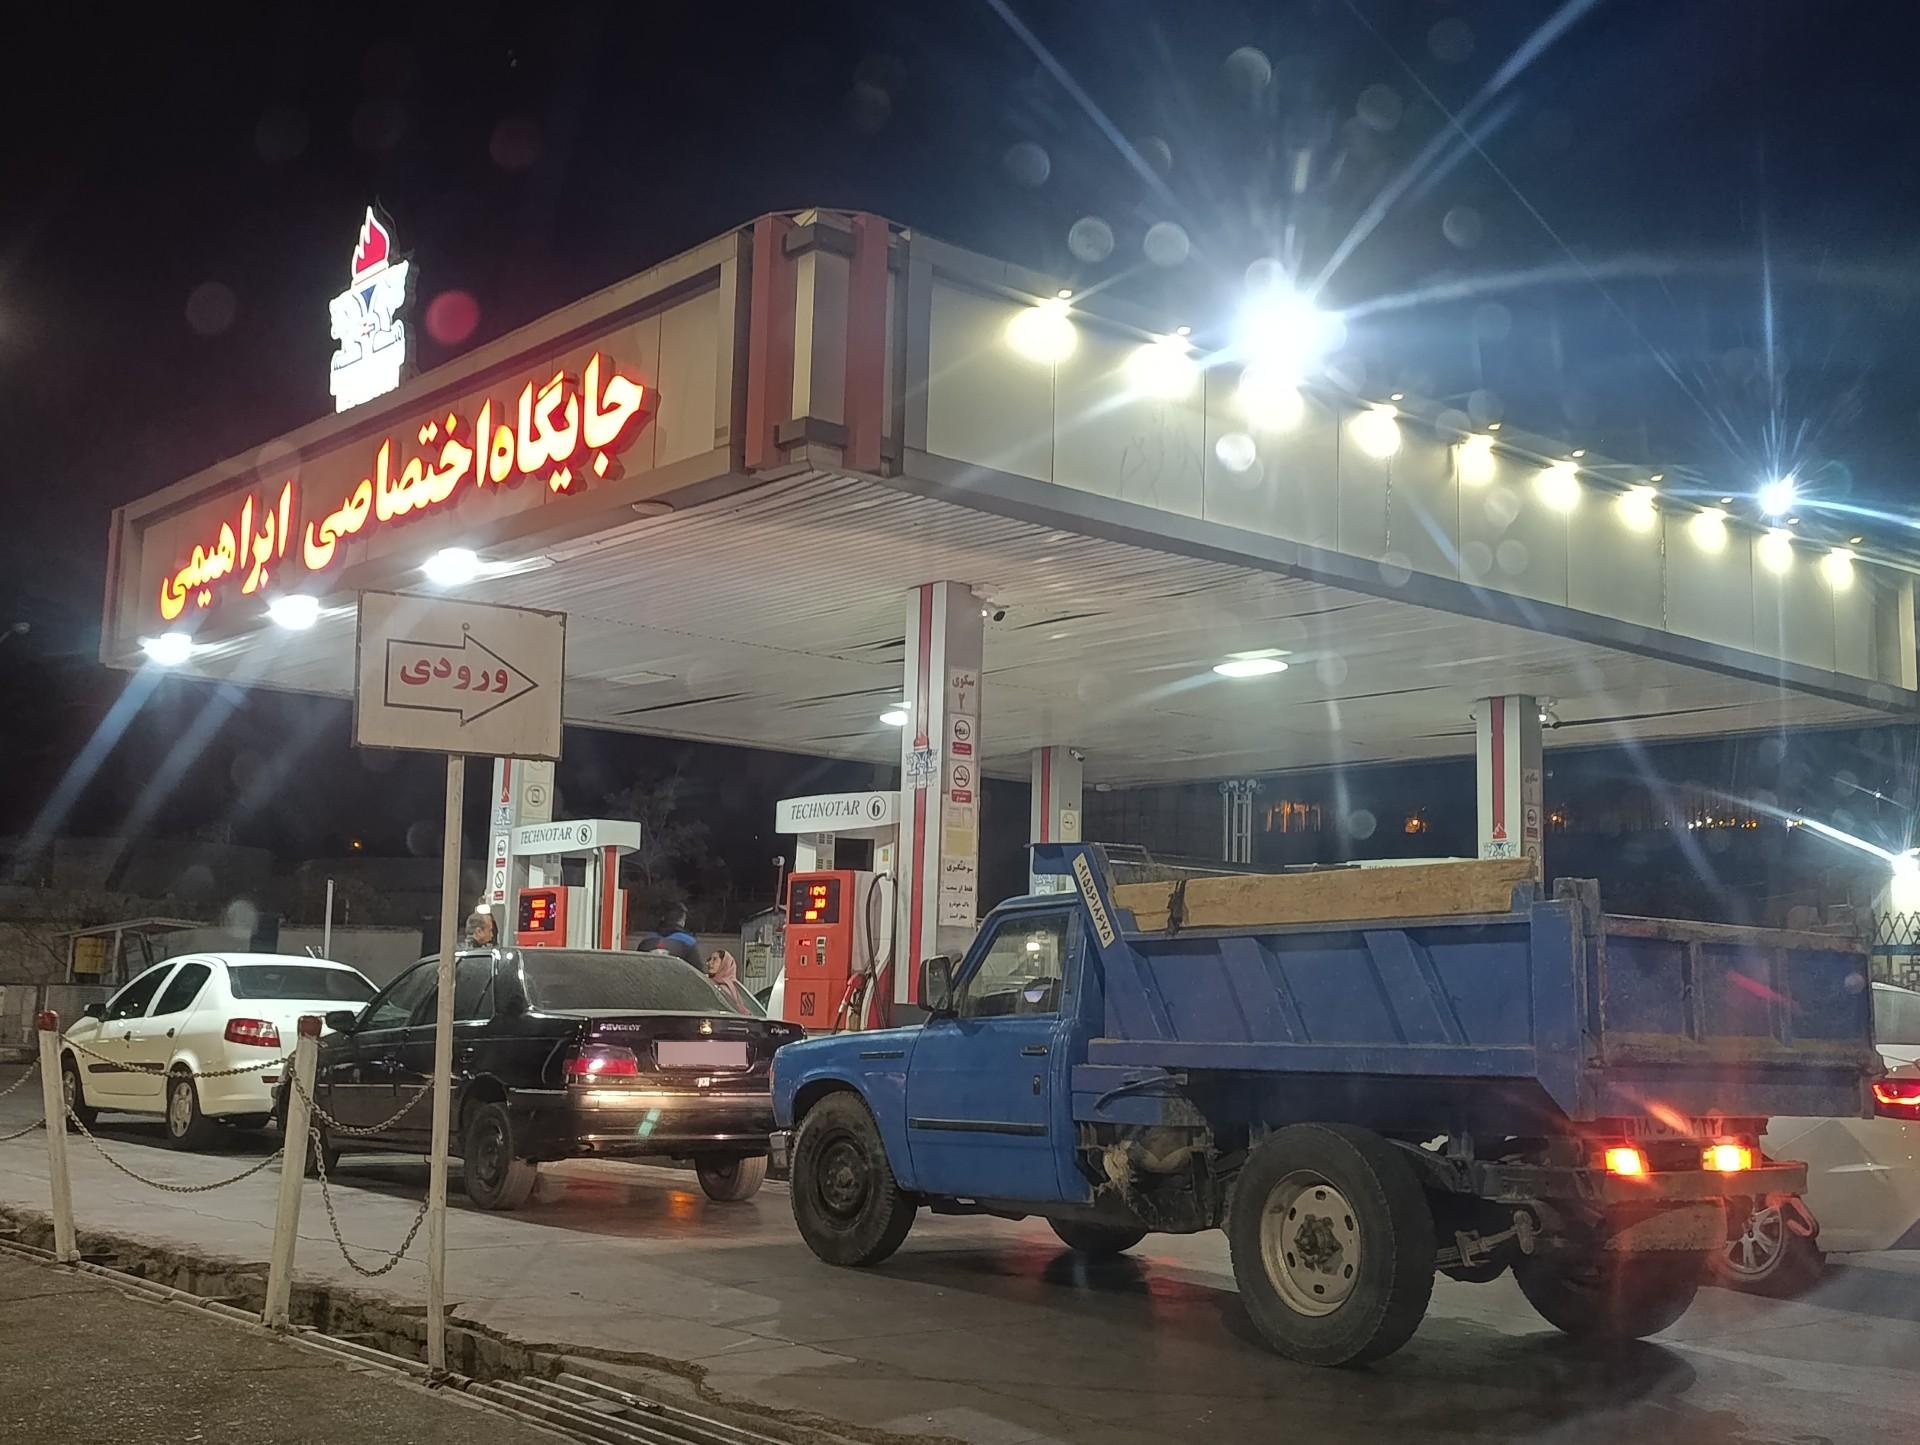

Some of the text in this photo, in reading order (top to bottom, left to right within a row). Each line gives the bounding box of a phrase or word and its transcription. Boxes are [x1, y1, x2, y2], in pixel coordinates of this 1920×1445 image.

[160, 352, 643, 620] جایگاه اختصاصی ابراهیمی
[400, 657, 508, 693] ورودی
[952, 674, 975, 688] سکوی
[791, 800, 880, 820] TECHNOTAR 6
[520, 827, 588, 844] TECHNOTAR 8
